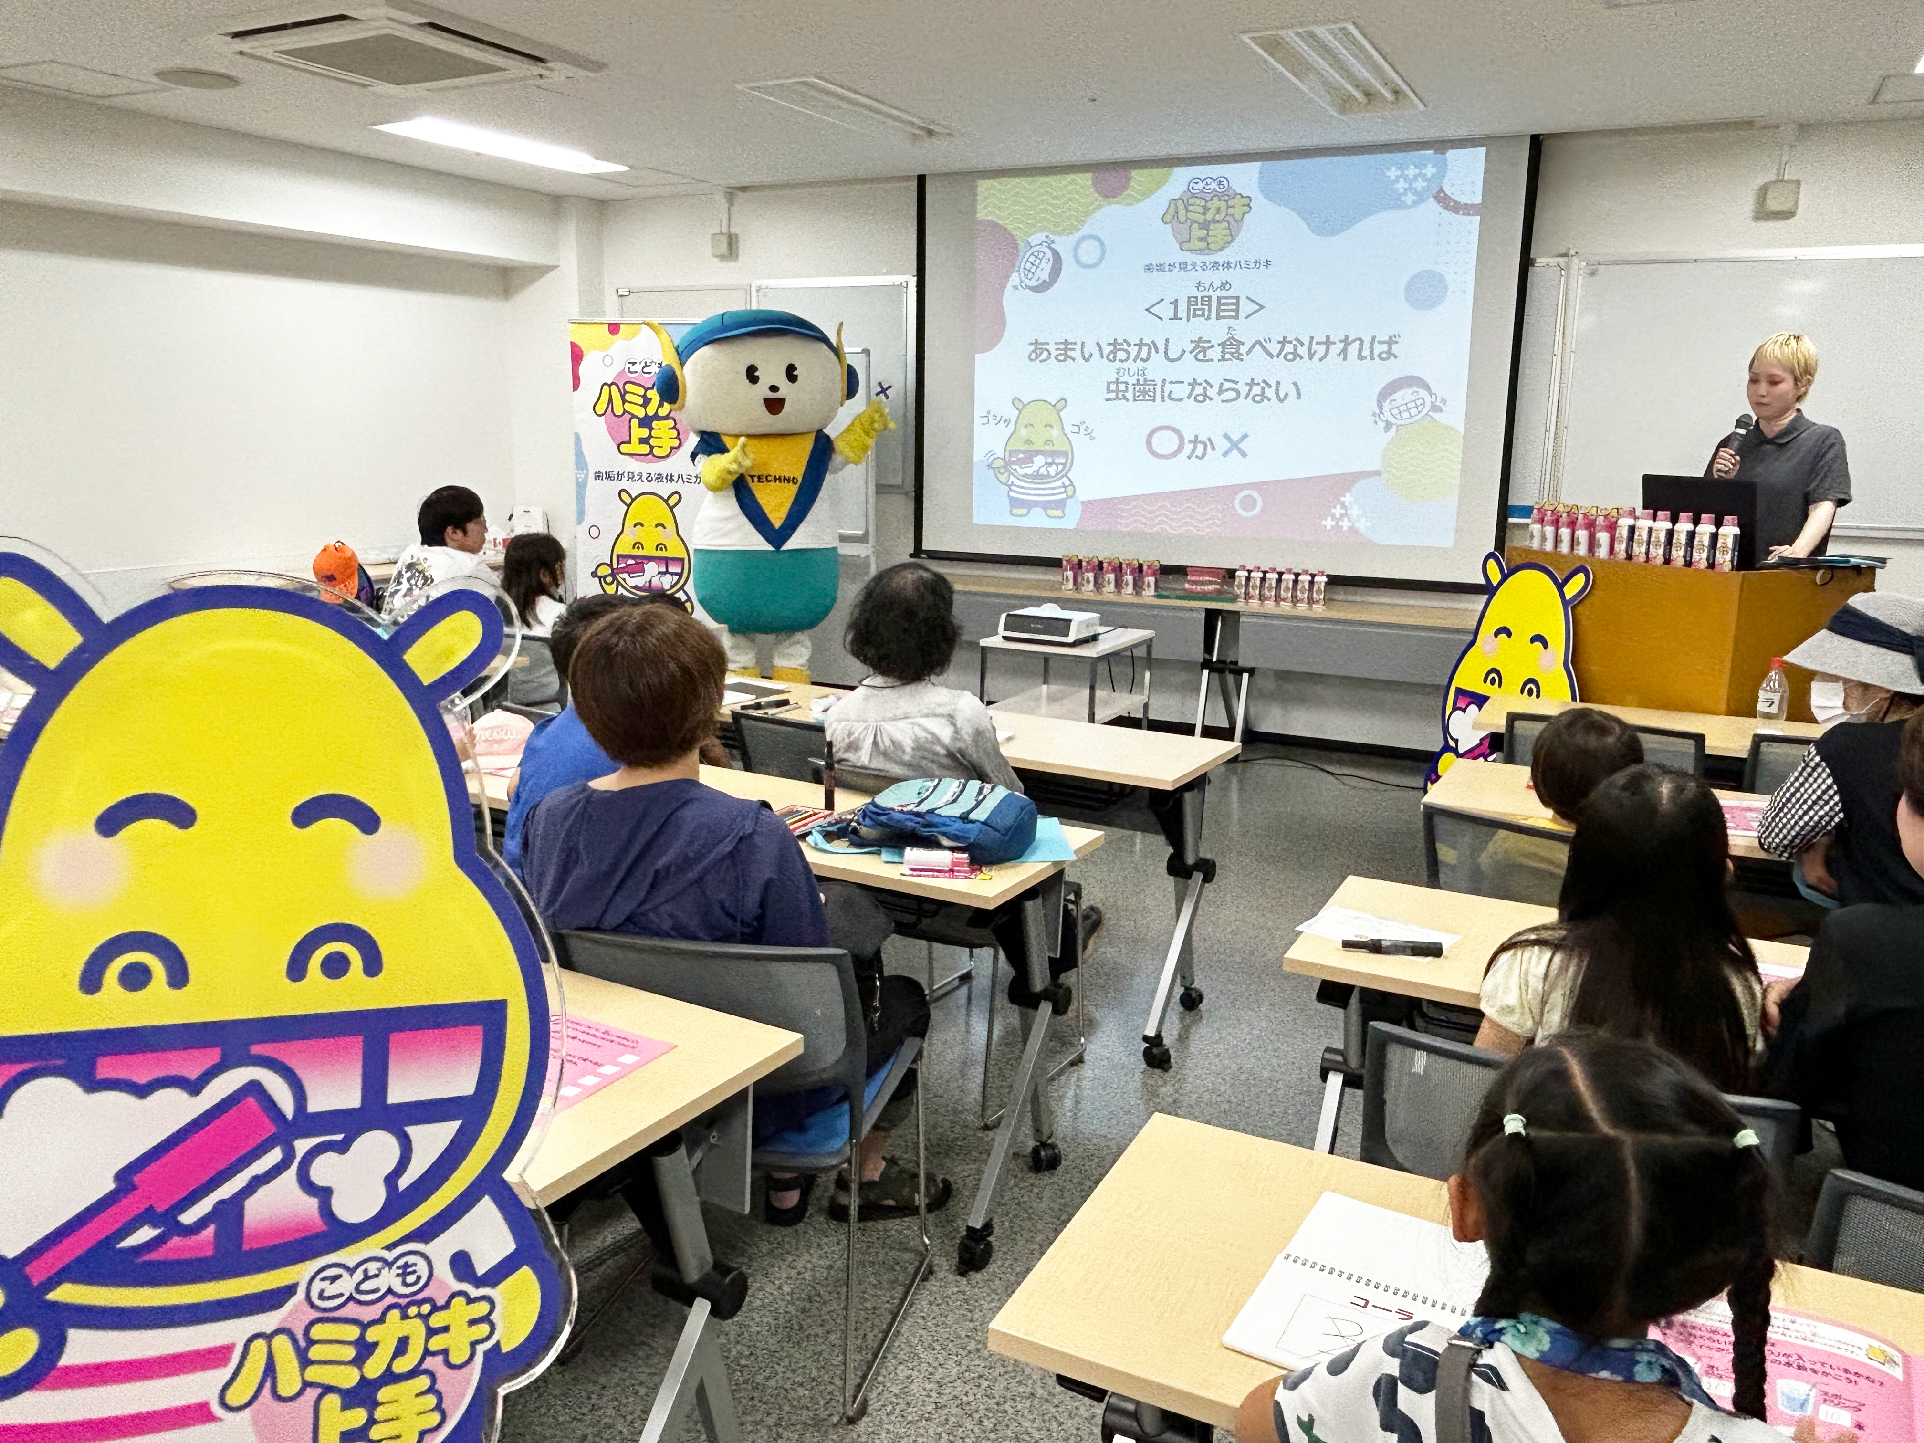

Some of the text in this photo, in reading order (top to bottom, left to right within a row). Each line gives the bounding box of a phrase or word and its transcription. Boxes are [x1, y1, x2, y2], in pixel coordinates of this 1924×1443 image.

[1162, 194, 1252, 224] ハミガキ
[1180, 221, 1233, 251] 上手
[1194, 281, 1232, 293] もんめ
[1027, 333, 1401, 364] あまいおかしを食べなければ
[1105, 376, 1302, 404] 虫歯にならない
[617, 417, 681, 459] 上手
[747, 474, 799, 485] TECHNO
[311, 1255, 427, 1306] こども
[1349, 1295, 1414, 1321] コーラ
[220, 1291, 496, 1411] ハミガキ
